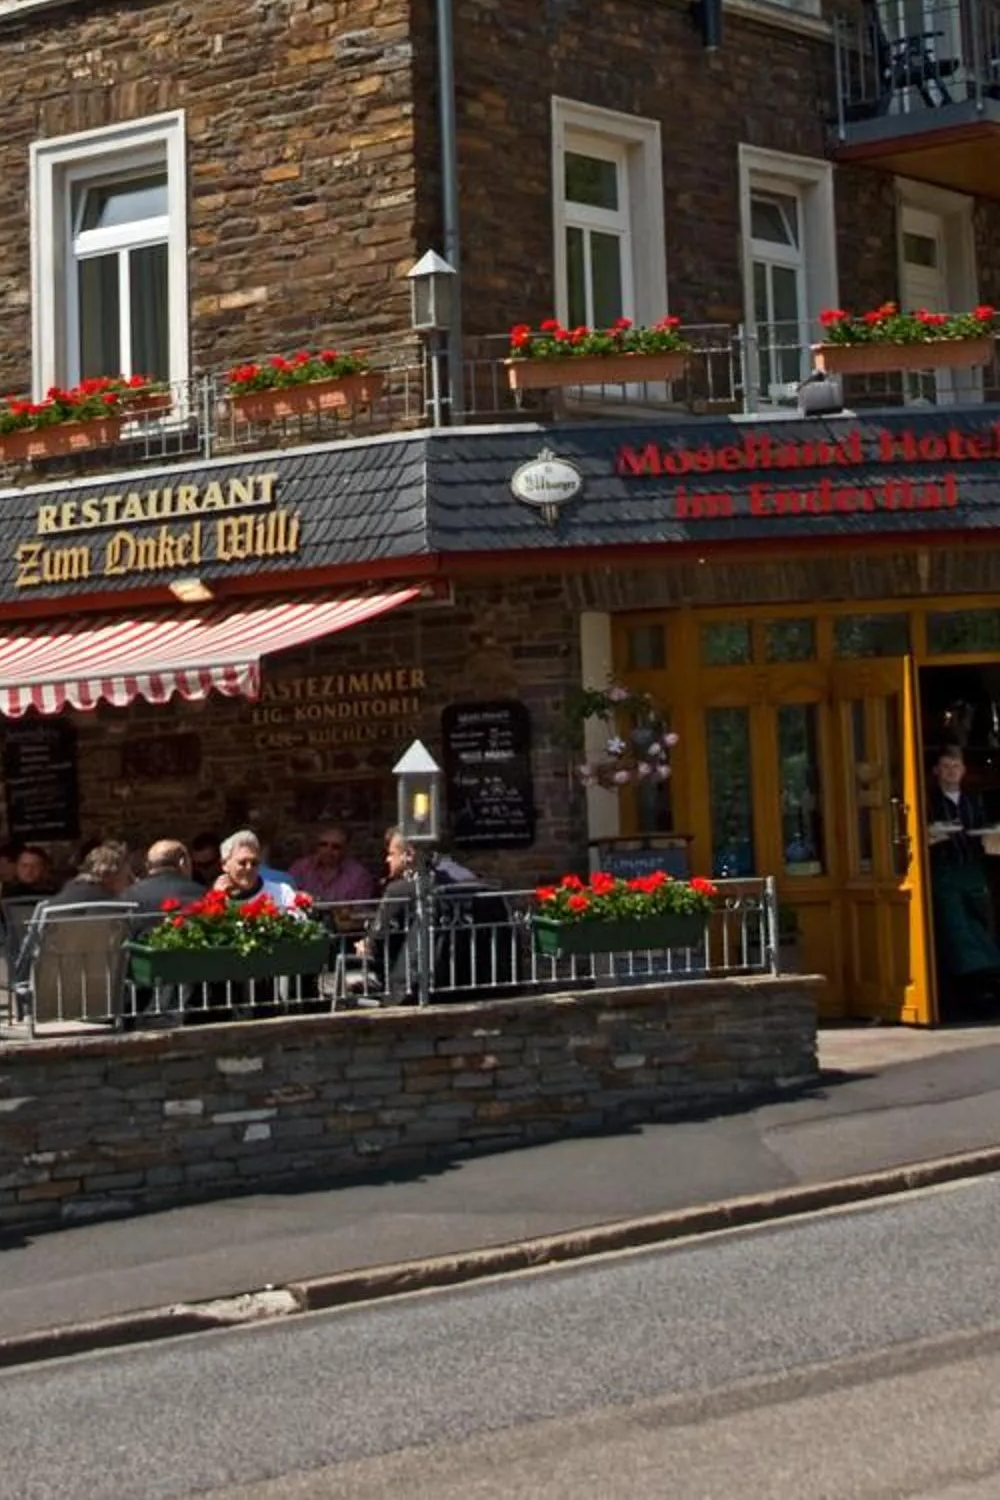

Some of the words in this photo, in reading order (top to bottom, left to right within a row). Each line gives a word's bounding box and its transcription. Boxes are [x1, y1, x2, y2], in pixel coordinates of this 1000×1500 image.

[617, 429, 864, 477] Moselland
[37, 472, 278, 535] RESTAURANT
[674, 485, 733, 518] im
[14, 541, 90, 588] Zum
[103, 522, 202, 576] Onkel
[217, 509, 300, 562] Willi
[294, 696, 419, 722] KONDITOREI
